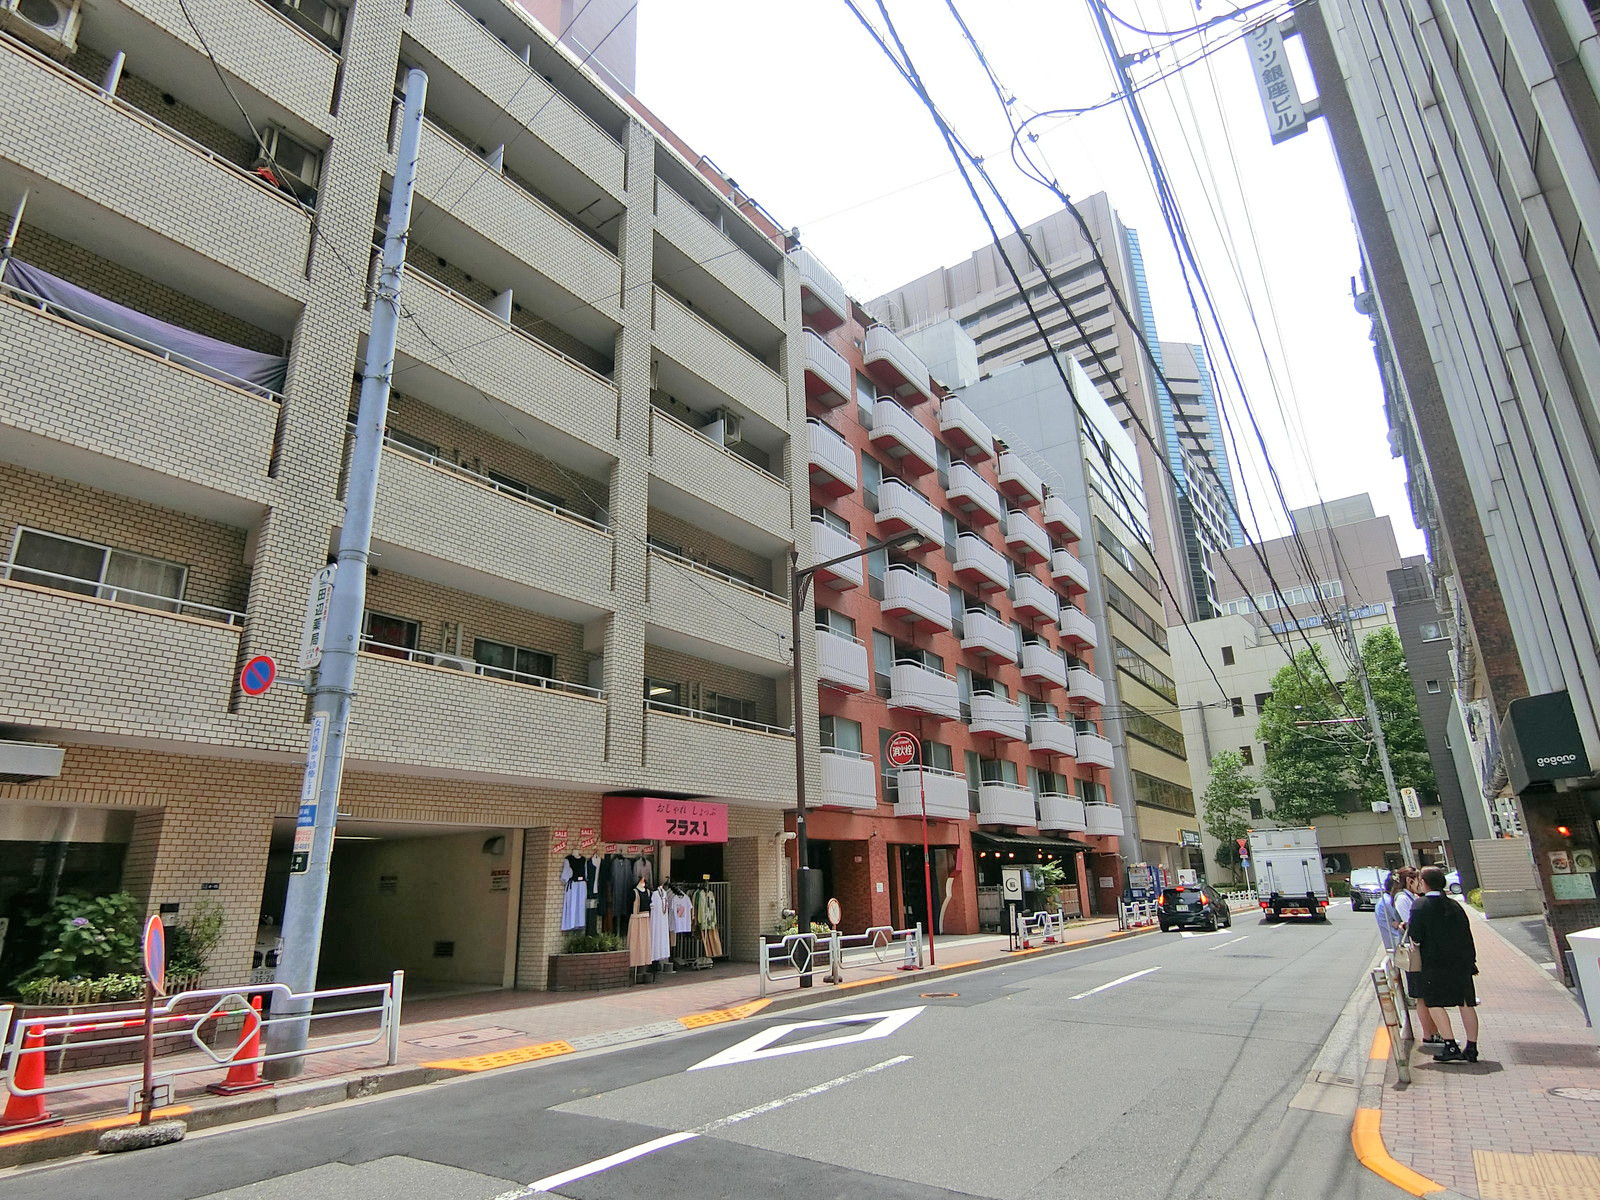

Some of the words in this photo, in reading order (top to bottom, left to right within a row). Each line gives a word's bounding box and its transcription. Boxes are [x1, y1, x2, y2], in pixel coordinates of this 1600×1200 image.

[892, 745, 913, 757] 消火栓
[1537, 754, 1576, 767] gogono
[656, 803, 687, 814] おしゃれ
[666, 819, 708, 836] プラス1
